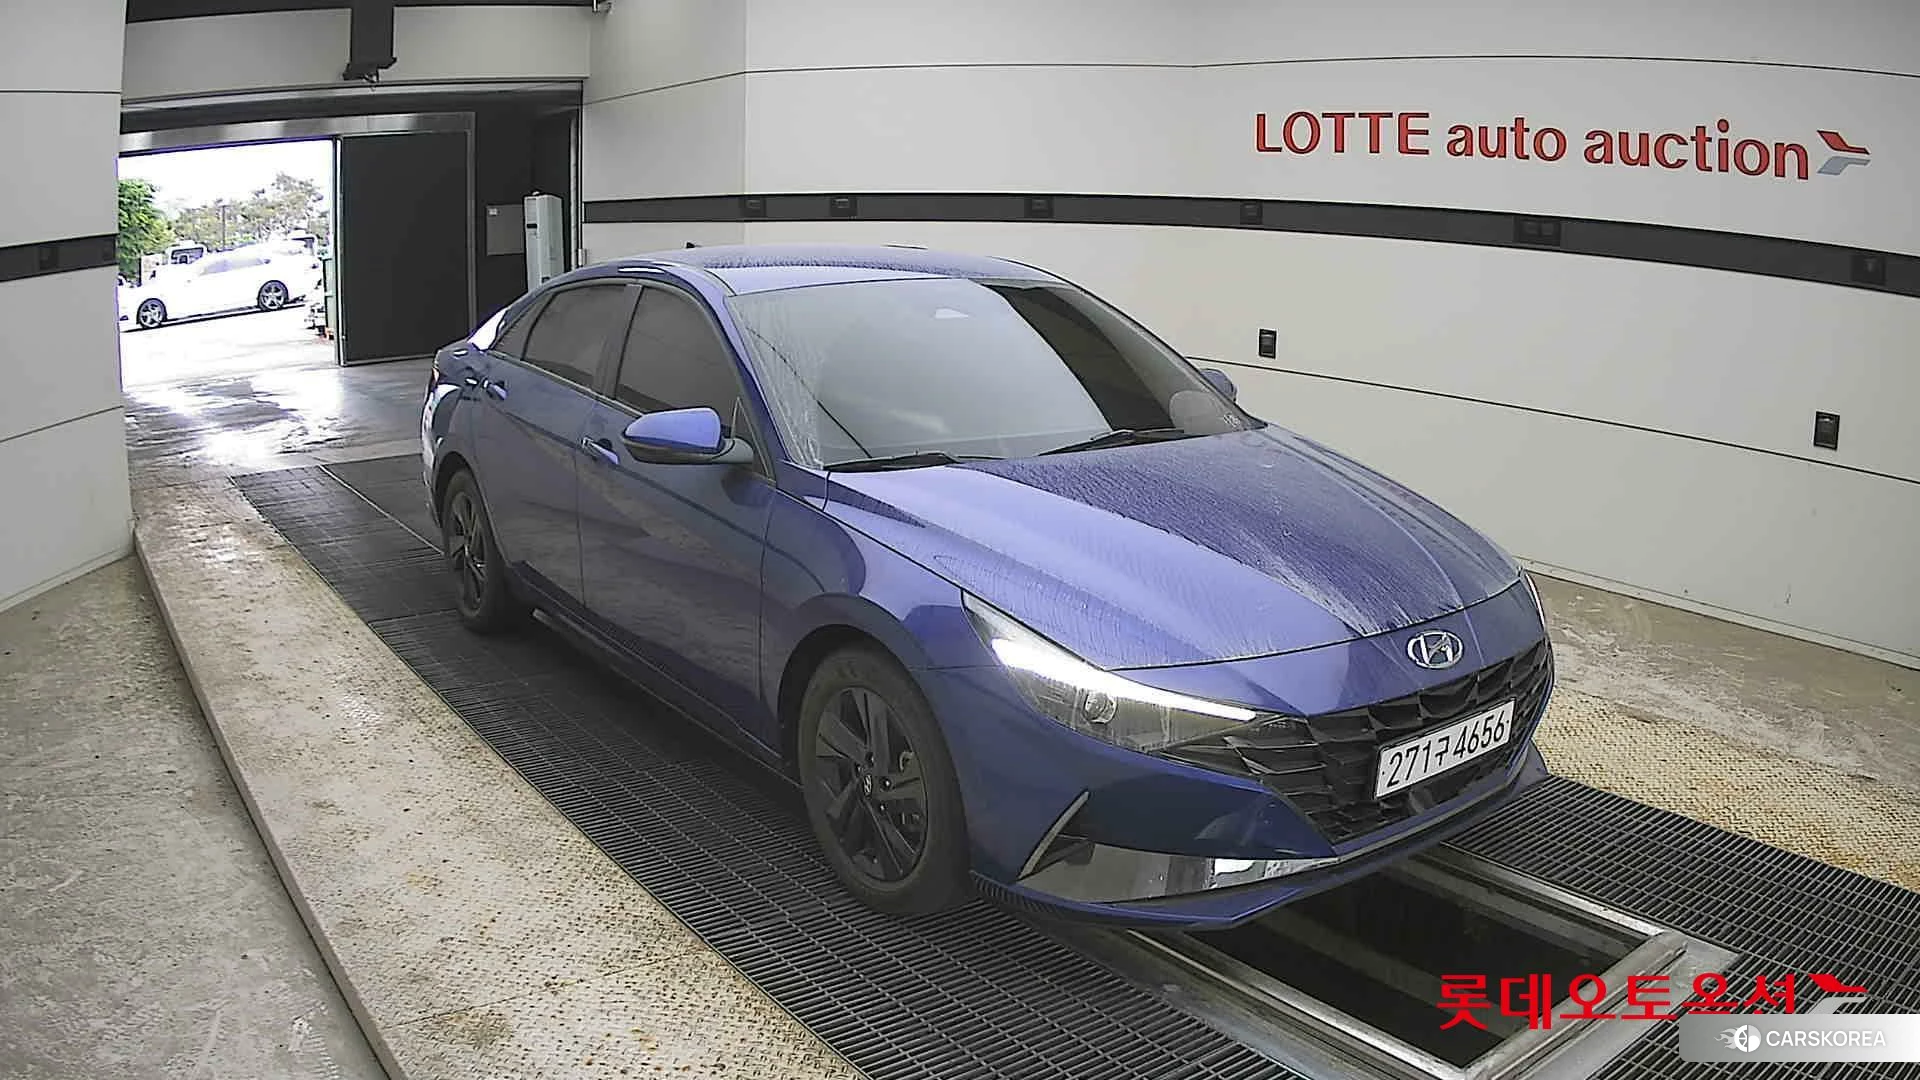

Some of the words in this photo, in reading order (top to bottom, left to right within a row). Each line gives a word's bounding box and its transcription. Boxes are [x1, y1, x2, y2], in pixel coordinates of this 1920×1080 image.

[1255, 111, 1430, 155] LOTTE
[1446, 116, 1568, 161] auto
[1583, 118, 1809, 181] auction
[1386, 709, 1505, 788] 271구4656
